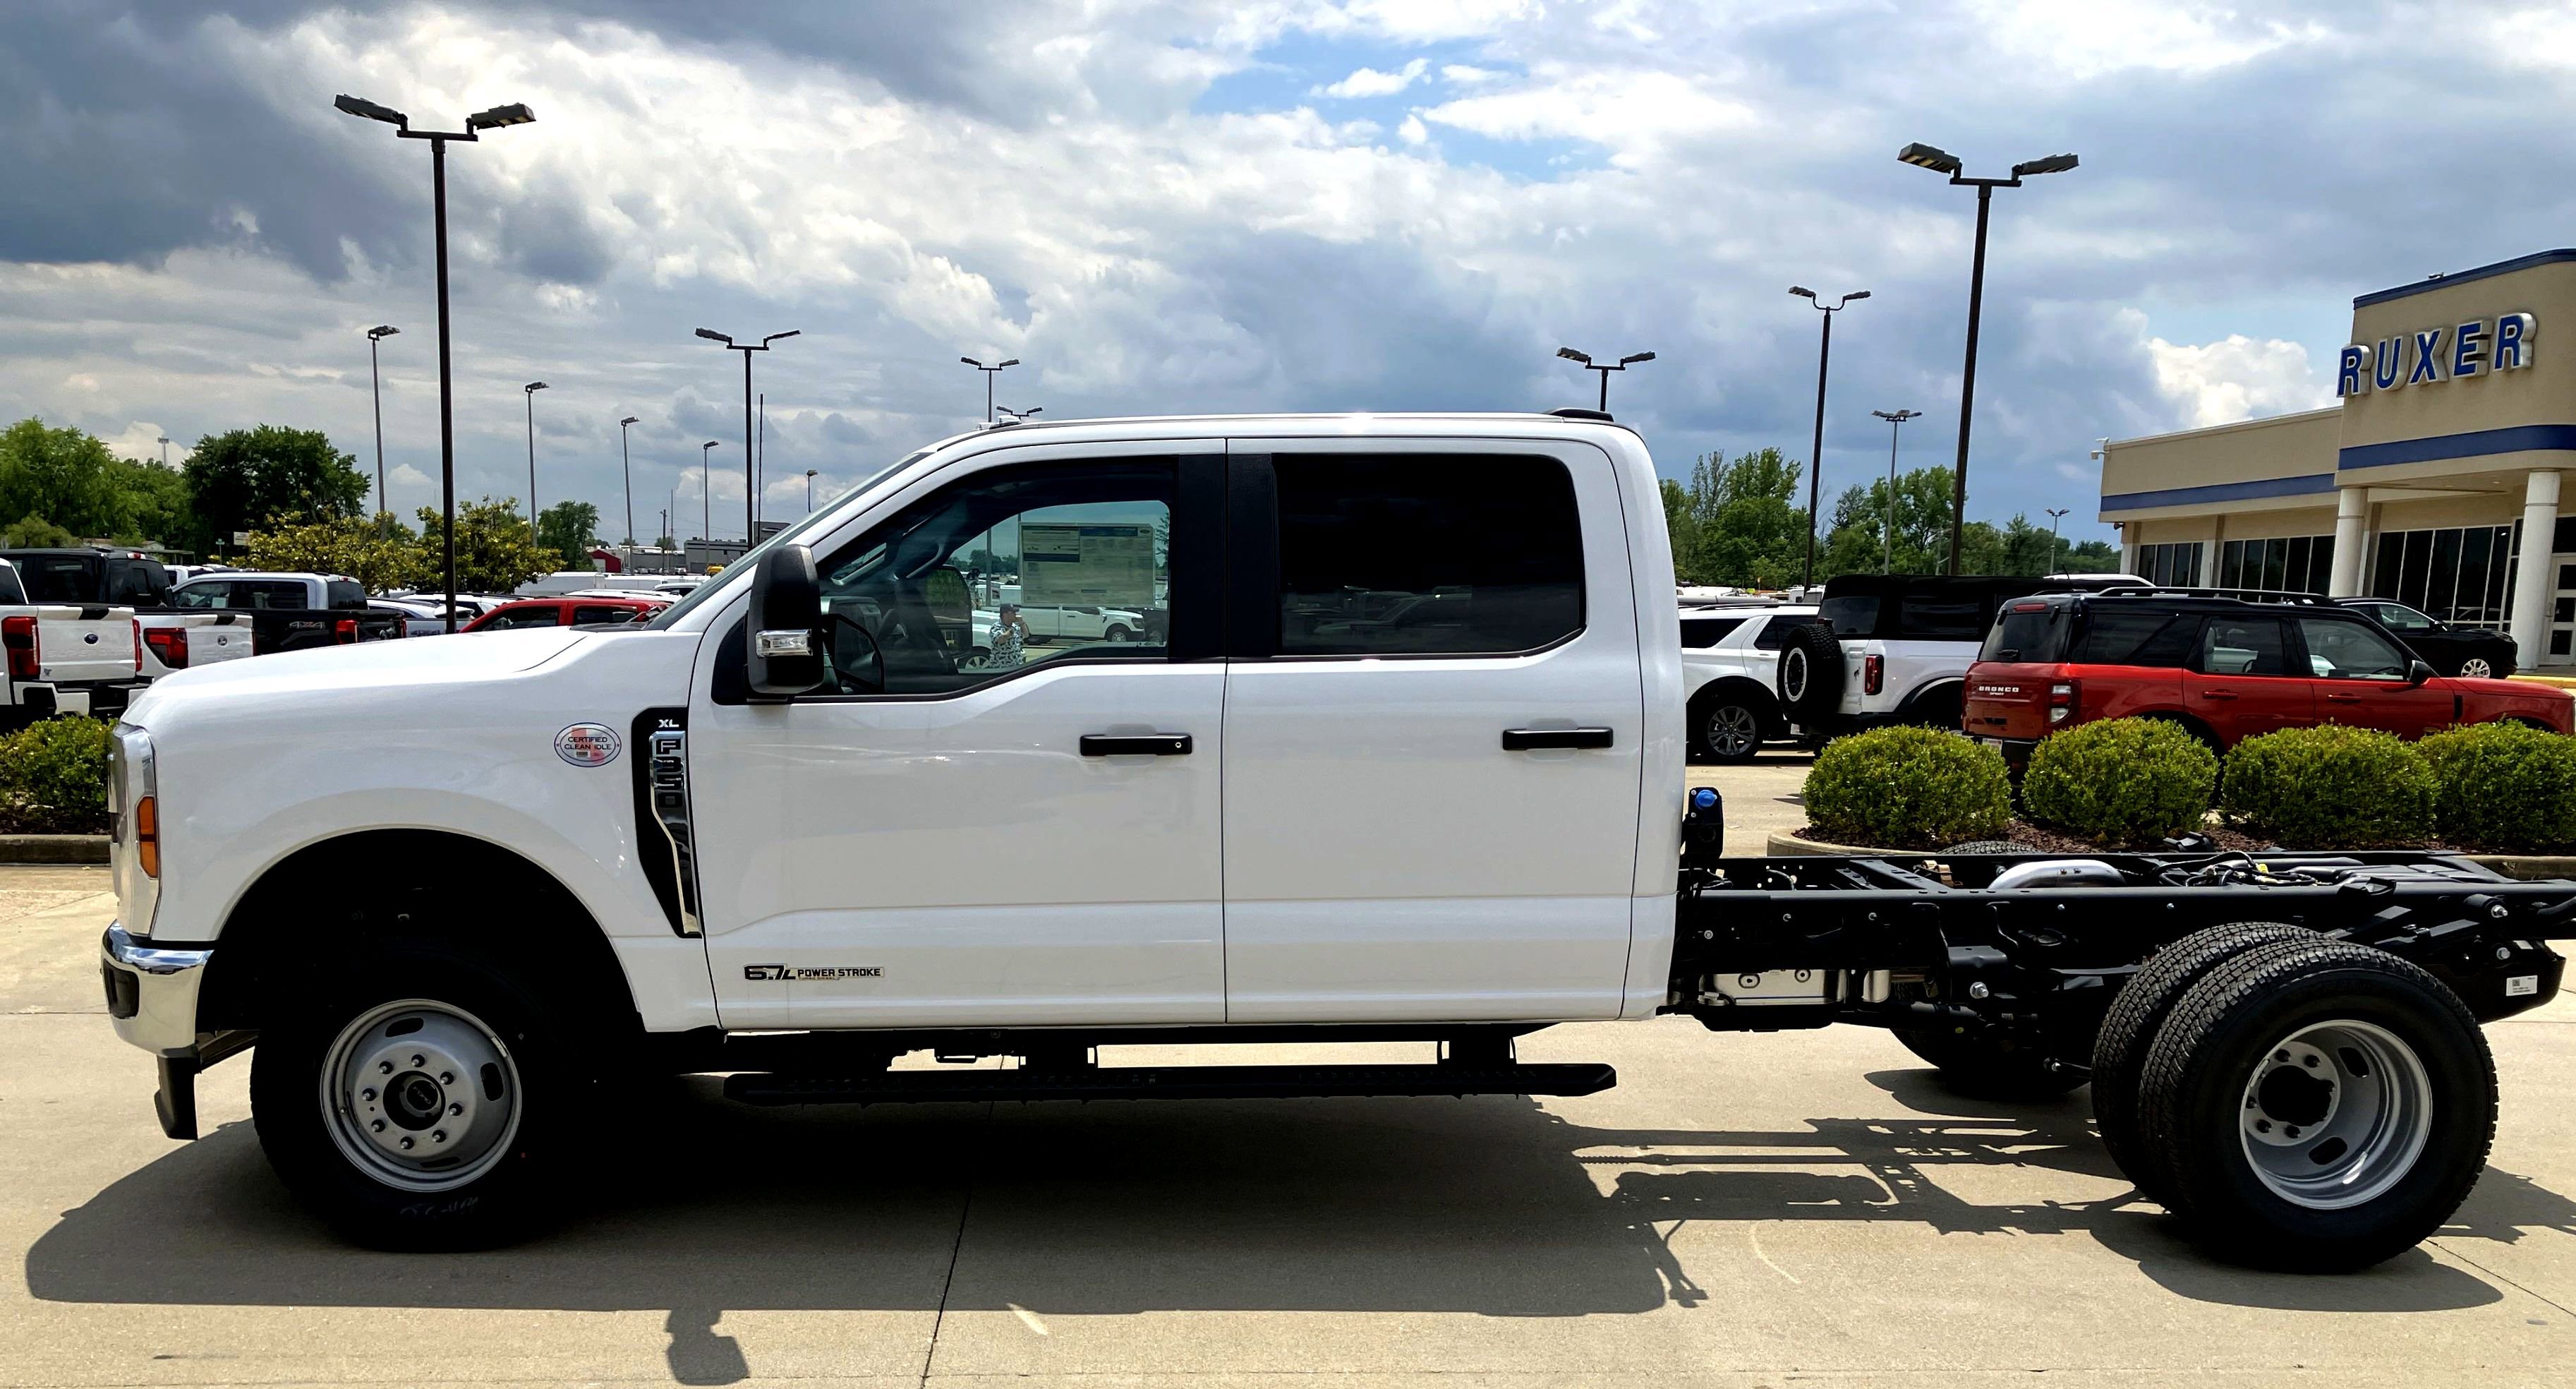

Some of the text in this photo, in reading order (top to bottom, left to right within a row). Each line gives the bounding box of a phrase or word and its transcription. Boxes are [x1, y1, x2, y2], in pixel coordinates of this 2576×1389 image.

[2336, 312, 2536, 397] RUXER
[658, 718, 679, 728] XL
[744, 965, 796, 980] 6.7L
[797, 968, 835, 977] POWER
[838, 968, 881, 977] STROKE
